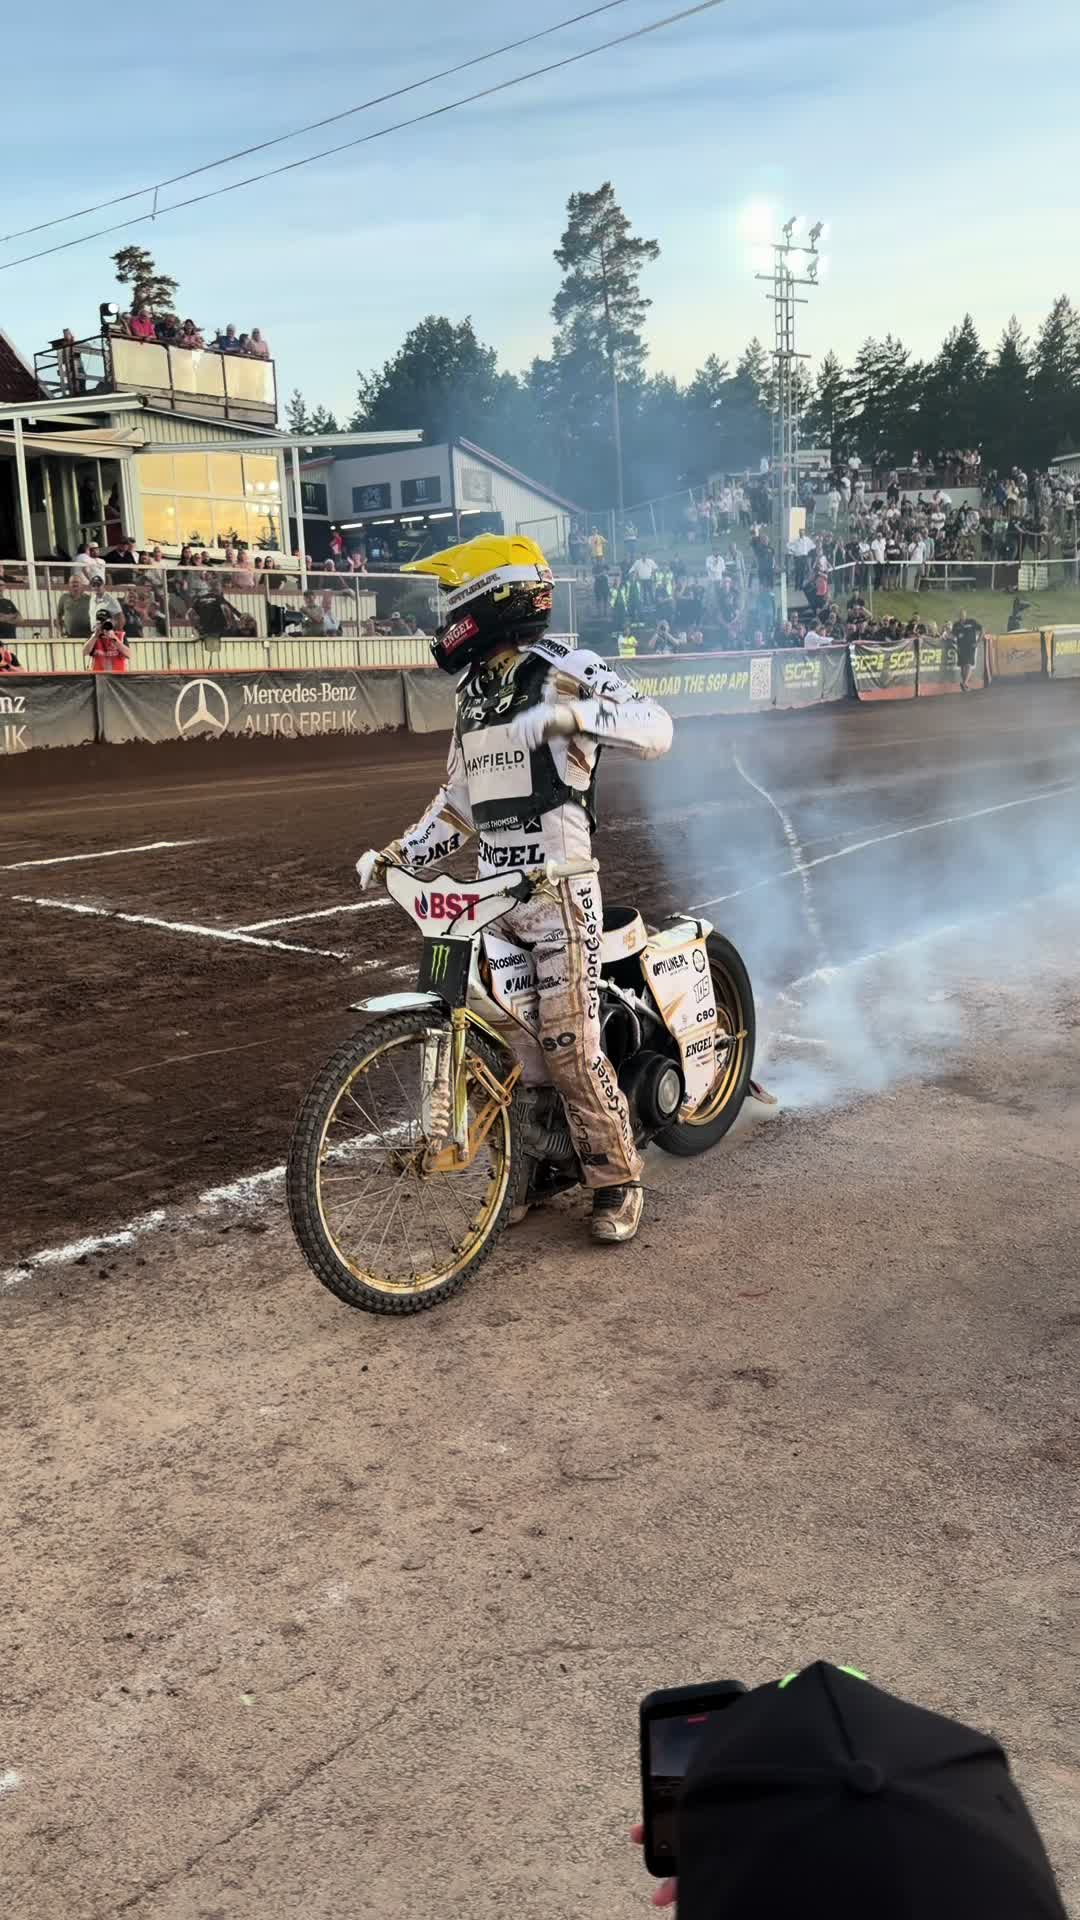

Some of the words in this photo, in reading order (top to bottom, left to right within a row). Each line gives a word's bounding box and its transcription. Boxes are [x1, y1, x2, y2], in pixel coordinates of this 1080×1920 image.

[442, 620, 473, 649] ENGEL
[242, 682, 357, 704] Mercedes-Benz
[683, 674, 705, 693] THE
[706, 672, 727, 690] SGP
[729, 671, 749, 689] APP
[244, 712, 297, 738] AUTO
[466, 750, 525, 771] MAYFIELD
[430, 893, 480, 920] BST
[685, 1036, 712, 1058] ENGEL
